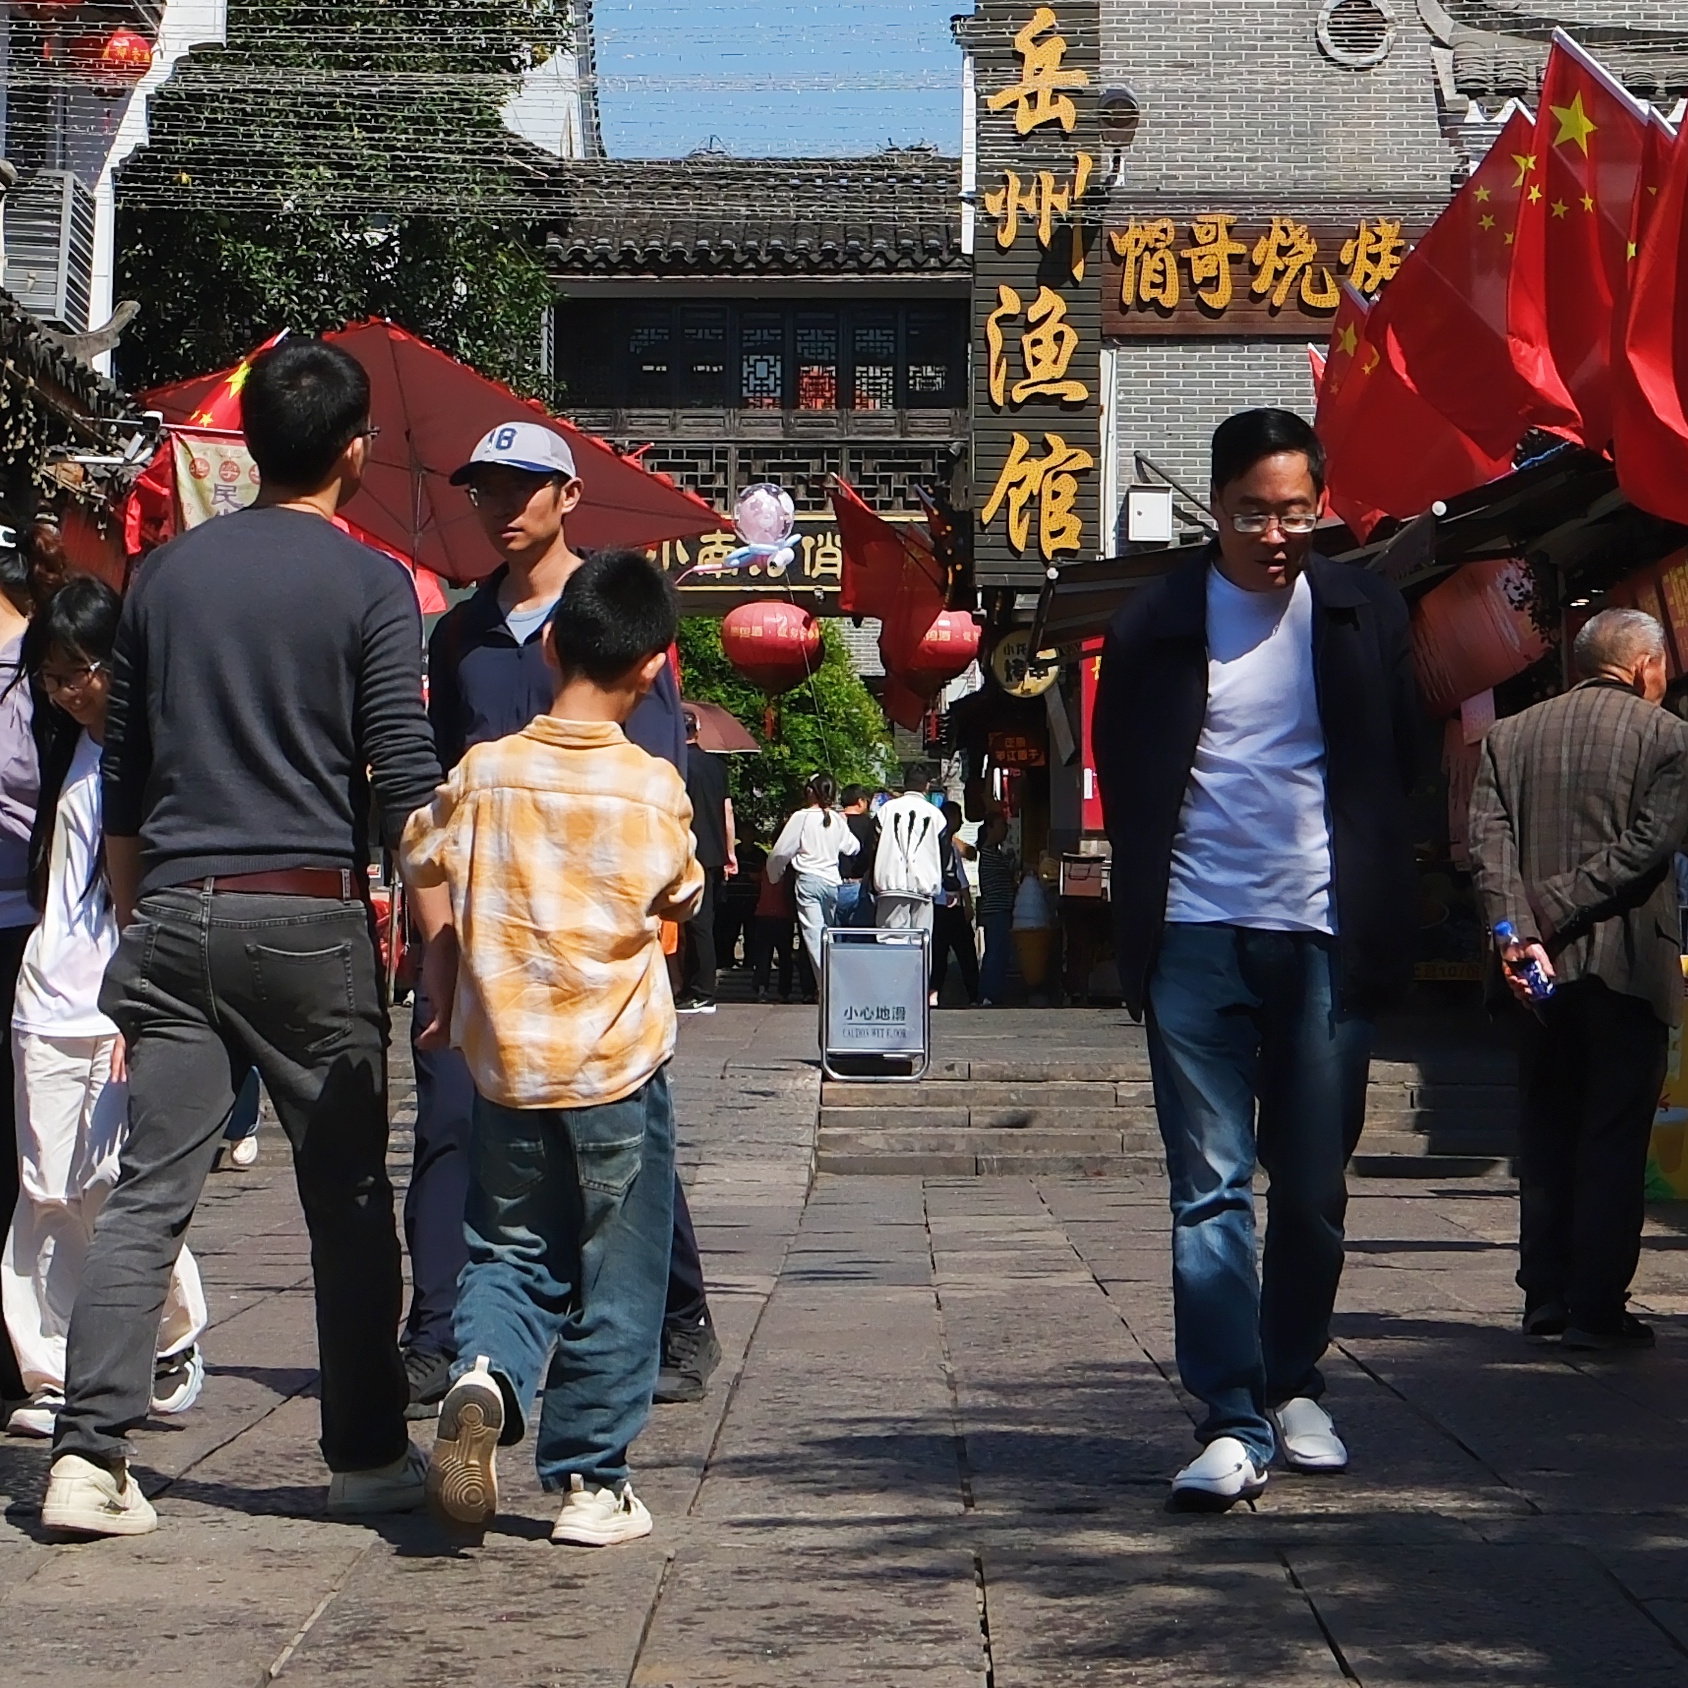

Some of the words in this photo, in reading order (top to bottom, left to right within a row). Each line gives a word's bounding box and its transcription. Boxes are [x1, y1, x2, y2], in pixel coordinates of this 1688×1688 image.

[981, 7, 1095, 561] 岳州渔馆
[1110, 213, 1406, 314] 帽哥烧烤
[645, 528, 843, 579] 小南俏
[843, 1005, 907, 1022] 小心地滑
